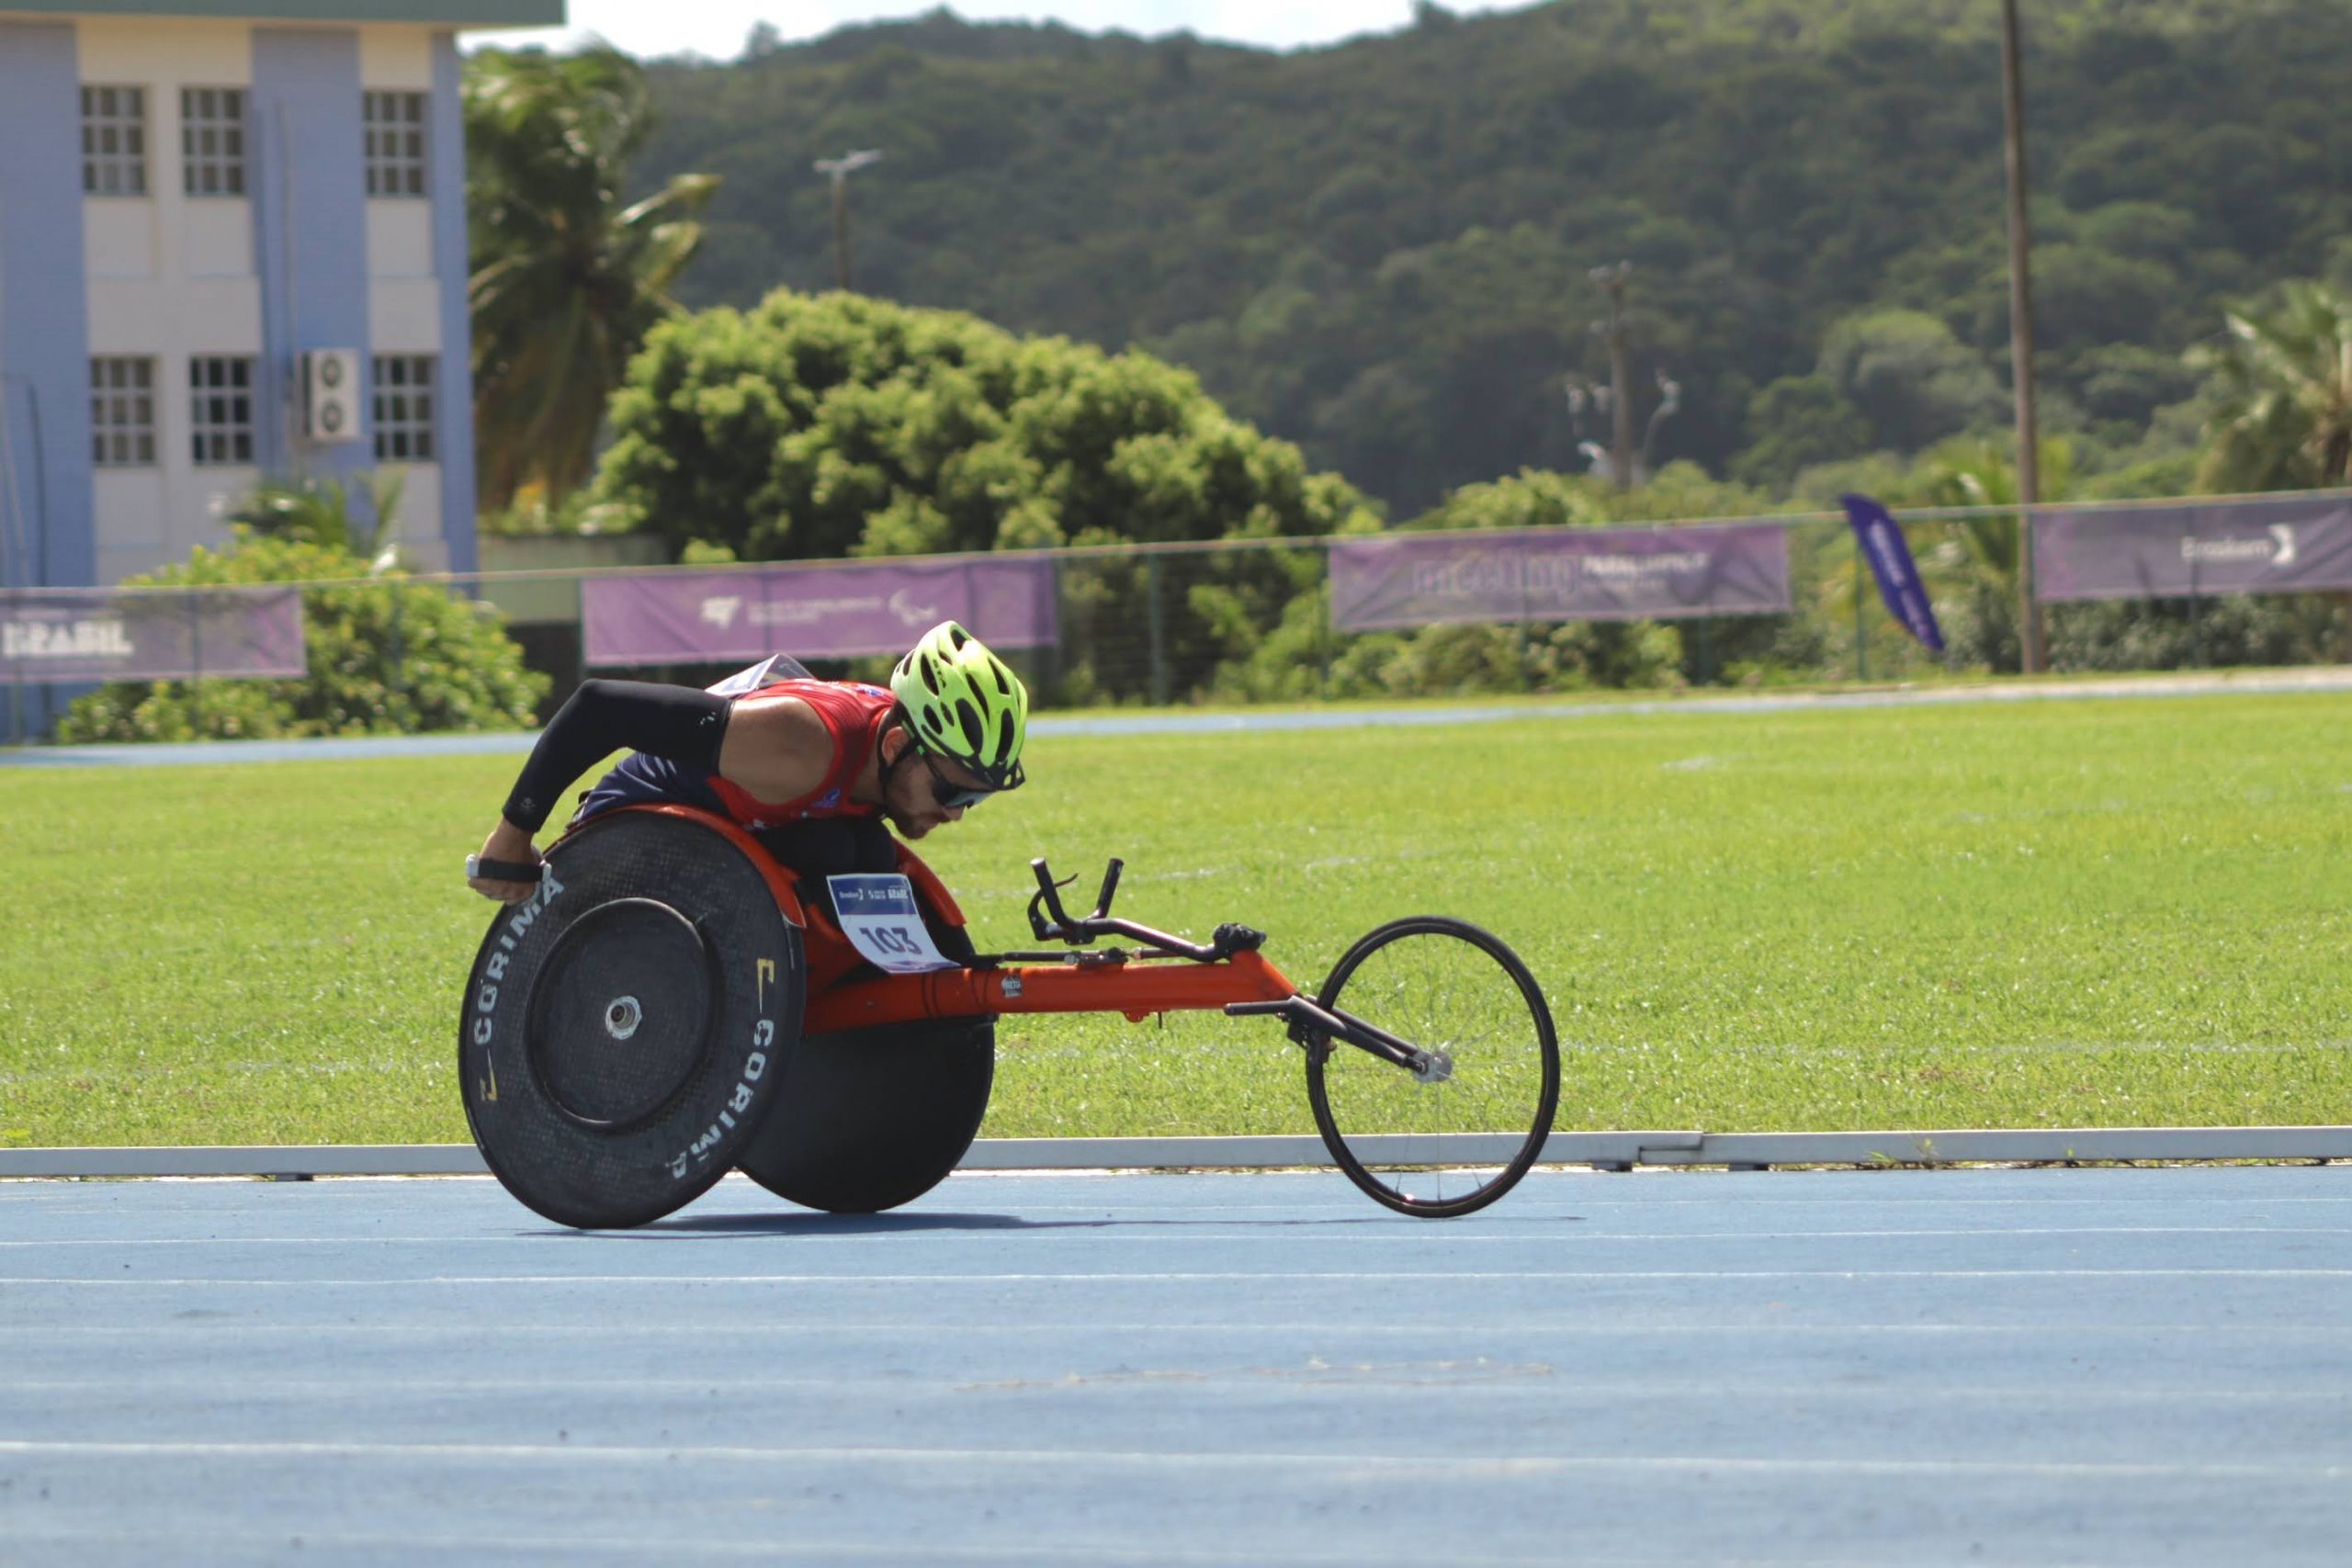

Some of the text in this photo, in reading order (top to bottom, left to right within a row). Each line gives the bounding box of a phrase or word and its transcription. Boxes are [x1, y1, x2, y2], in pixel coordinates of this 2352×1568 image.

[473, 876, 565, 1045] CORIMA
[858, 927, 922, 954] 103
[665, 1019, 774, 1179] CORIMA
